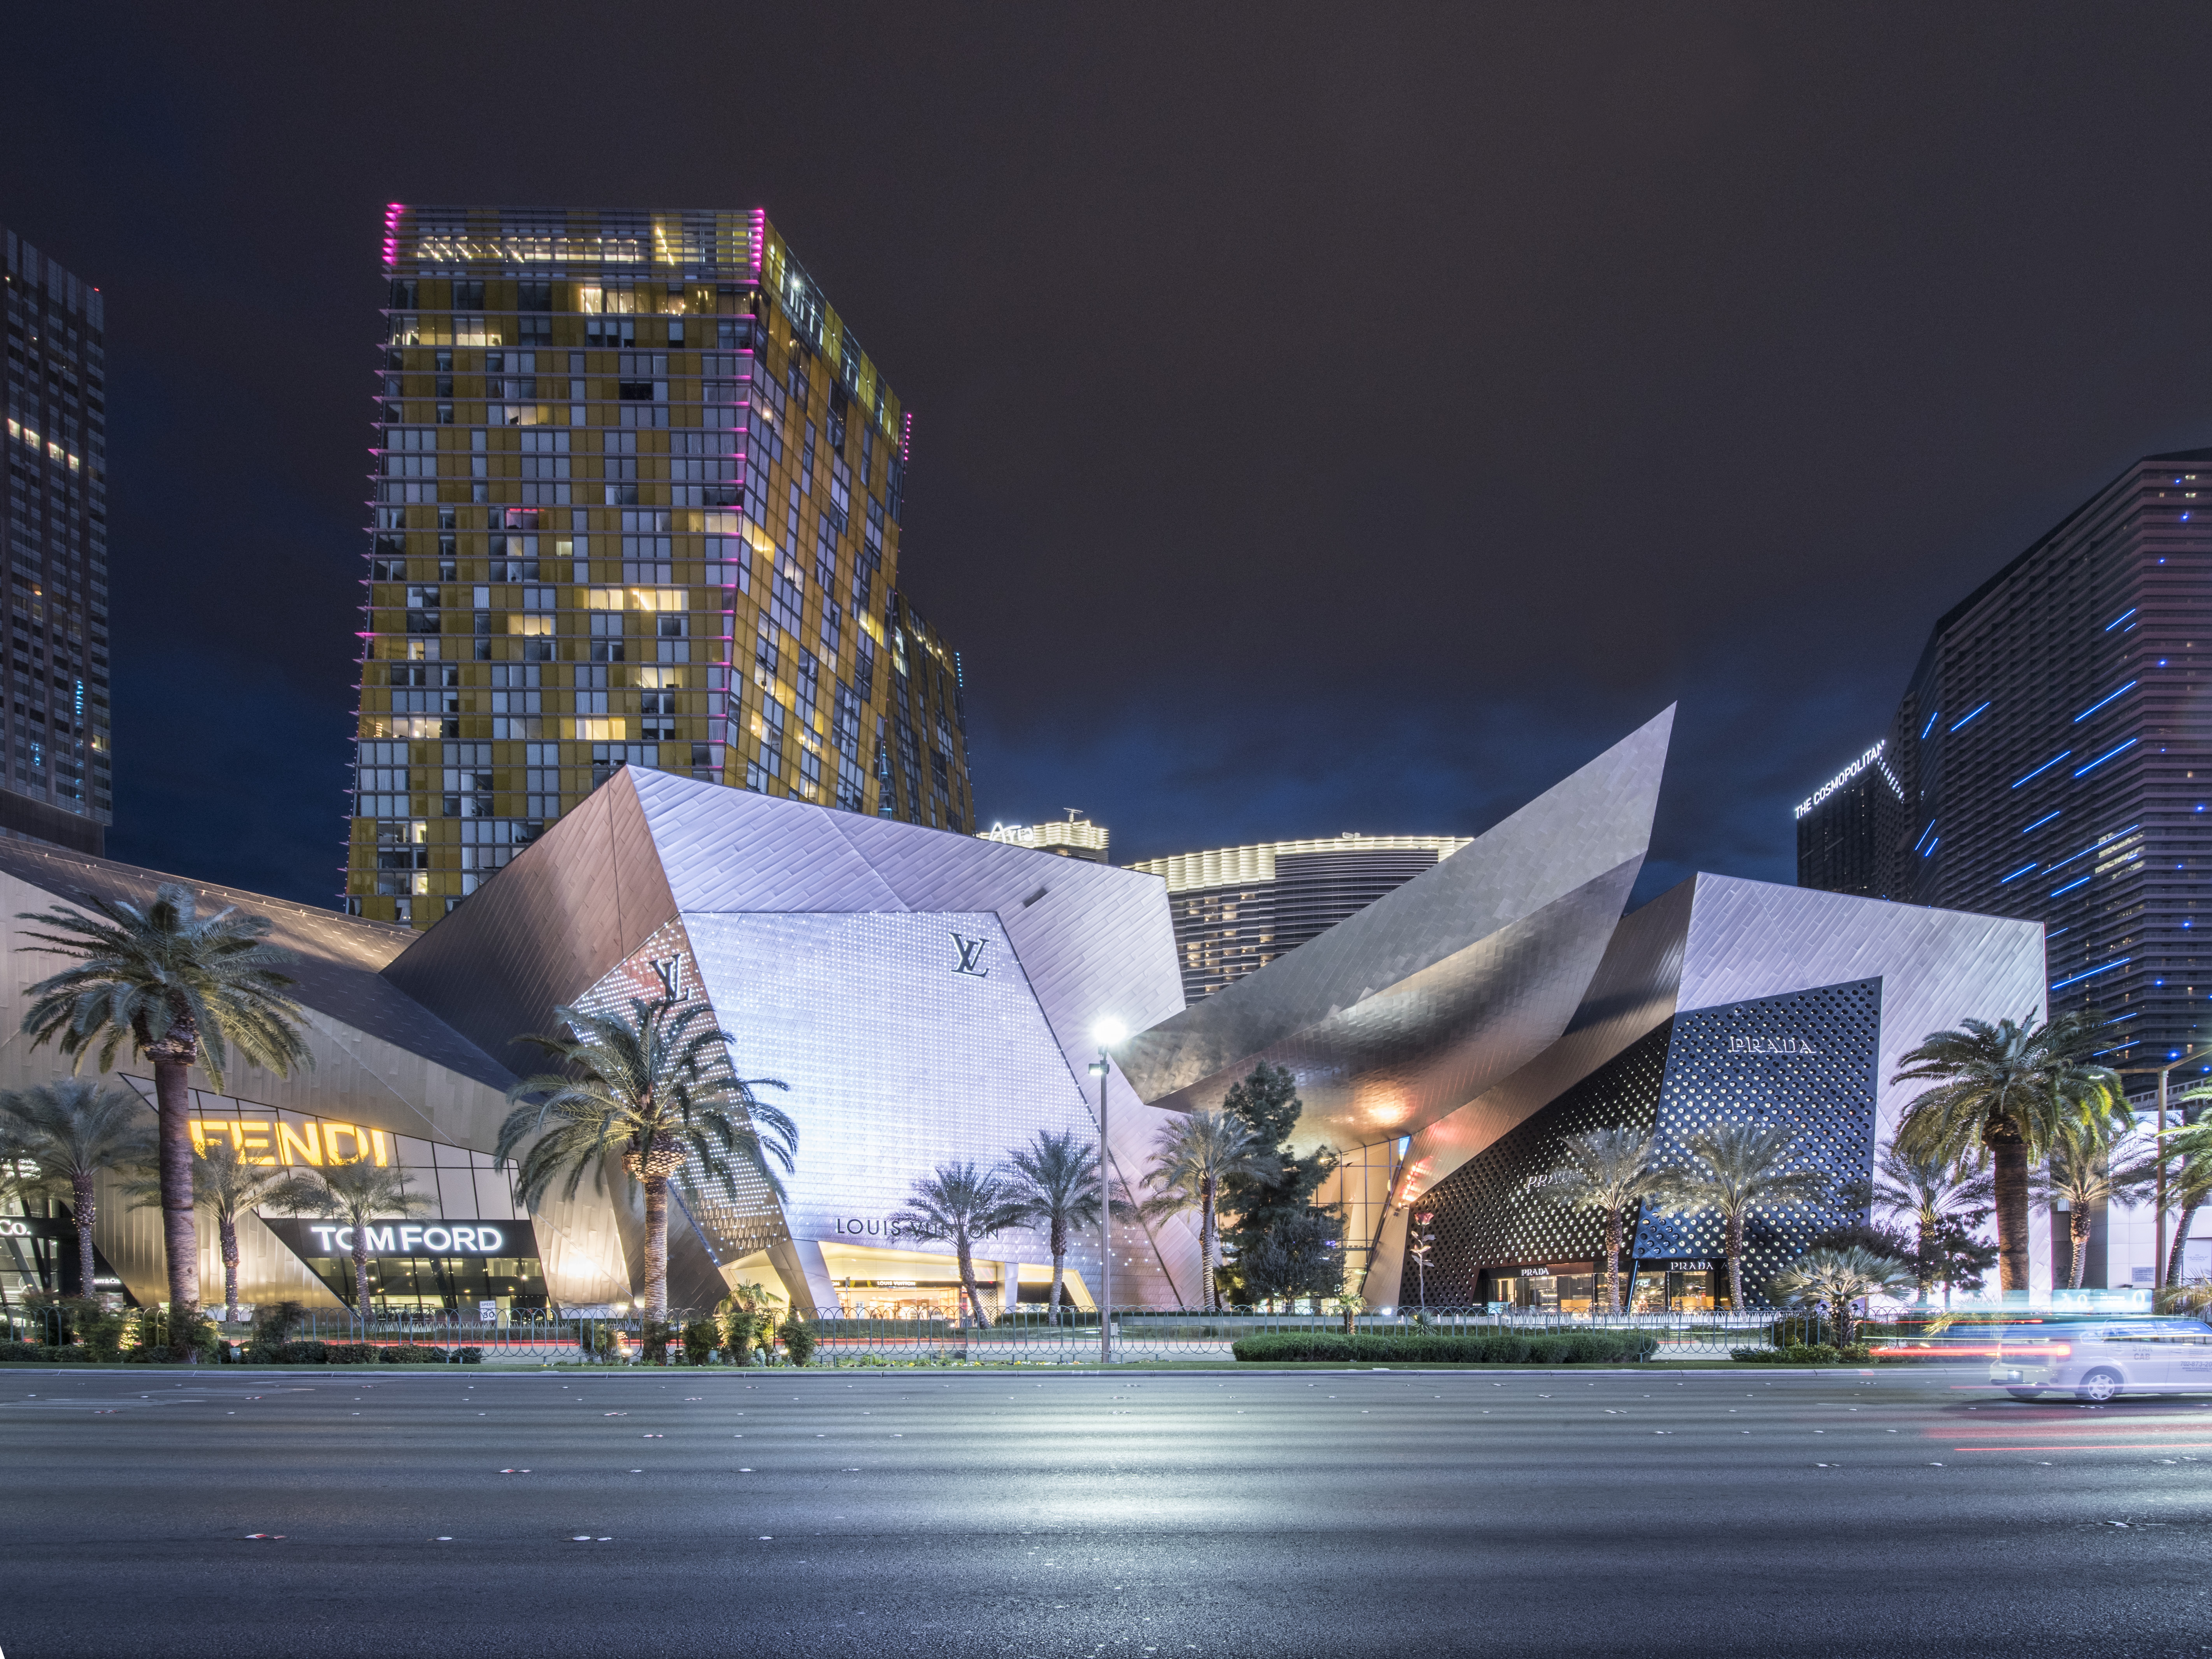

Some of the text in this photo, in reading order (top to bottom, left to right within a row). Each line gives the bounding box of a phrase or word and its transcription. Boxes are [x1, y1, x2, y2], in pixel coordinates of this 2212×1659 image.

[1795, 797, 1812, 819] THE
[1813, 740, 1885, 805] COSMOPOLITAN
[1731, 1038, 1817, 1053] PRADA
[190, 1121, 387, 1167] FENDI
[1524, 1171, 1572, 1189] PRAD
[837, 1218, 901, 1236] LOUIS
[311, 1227, 502, 1250] TOM FORD
[1521, 1268, 1549, 1276] PRADA
